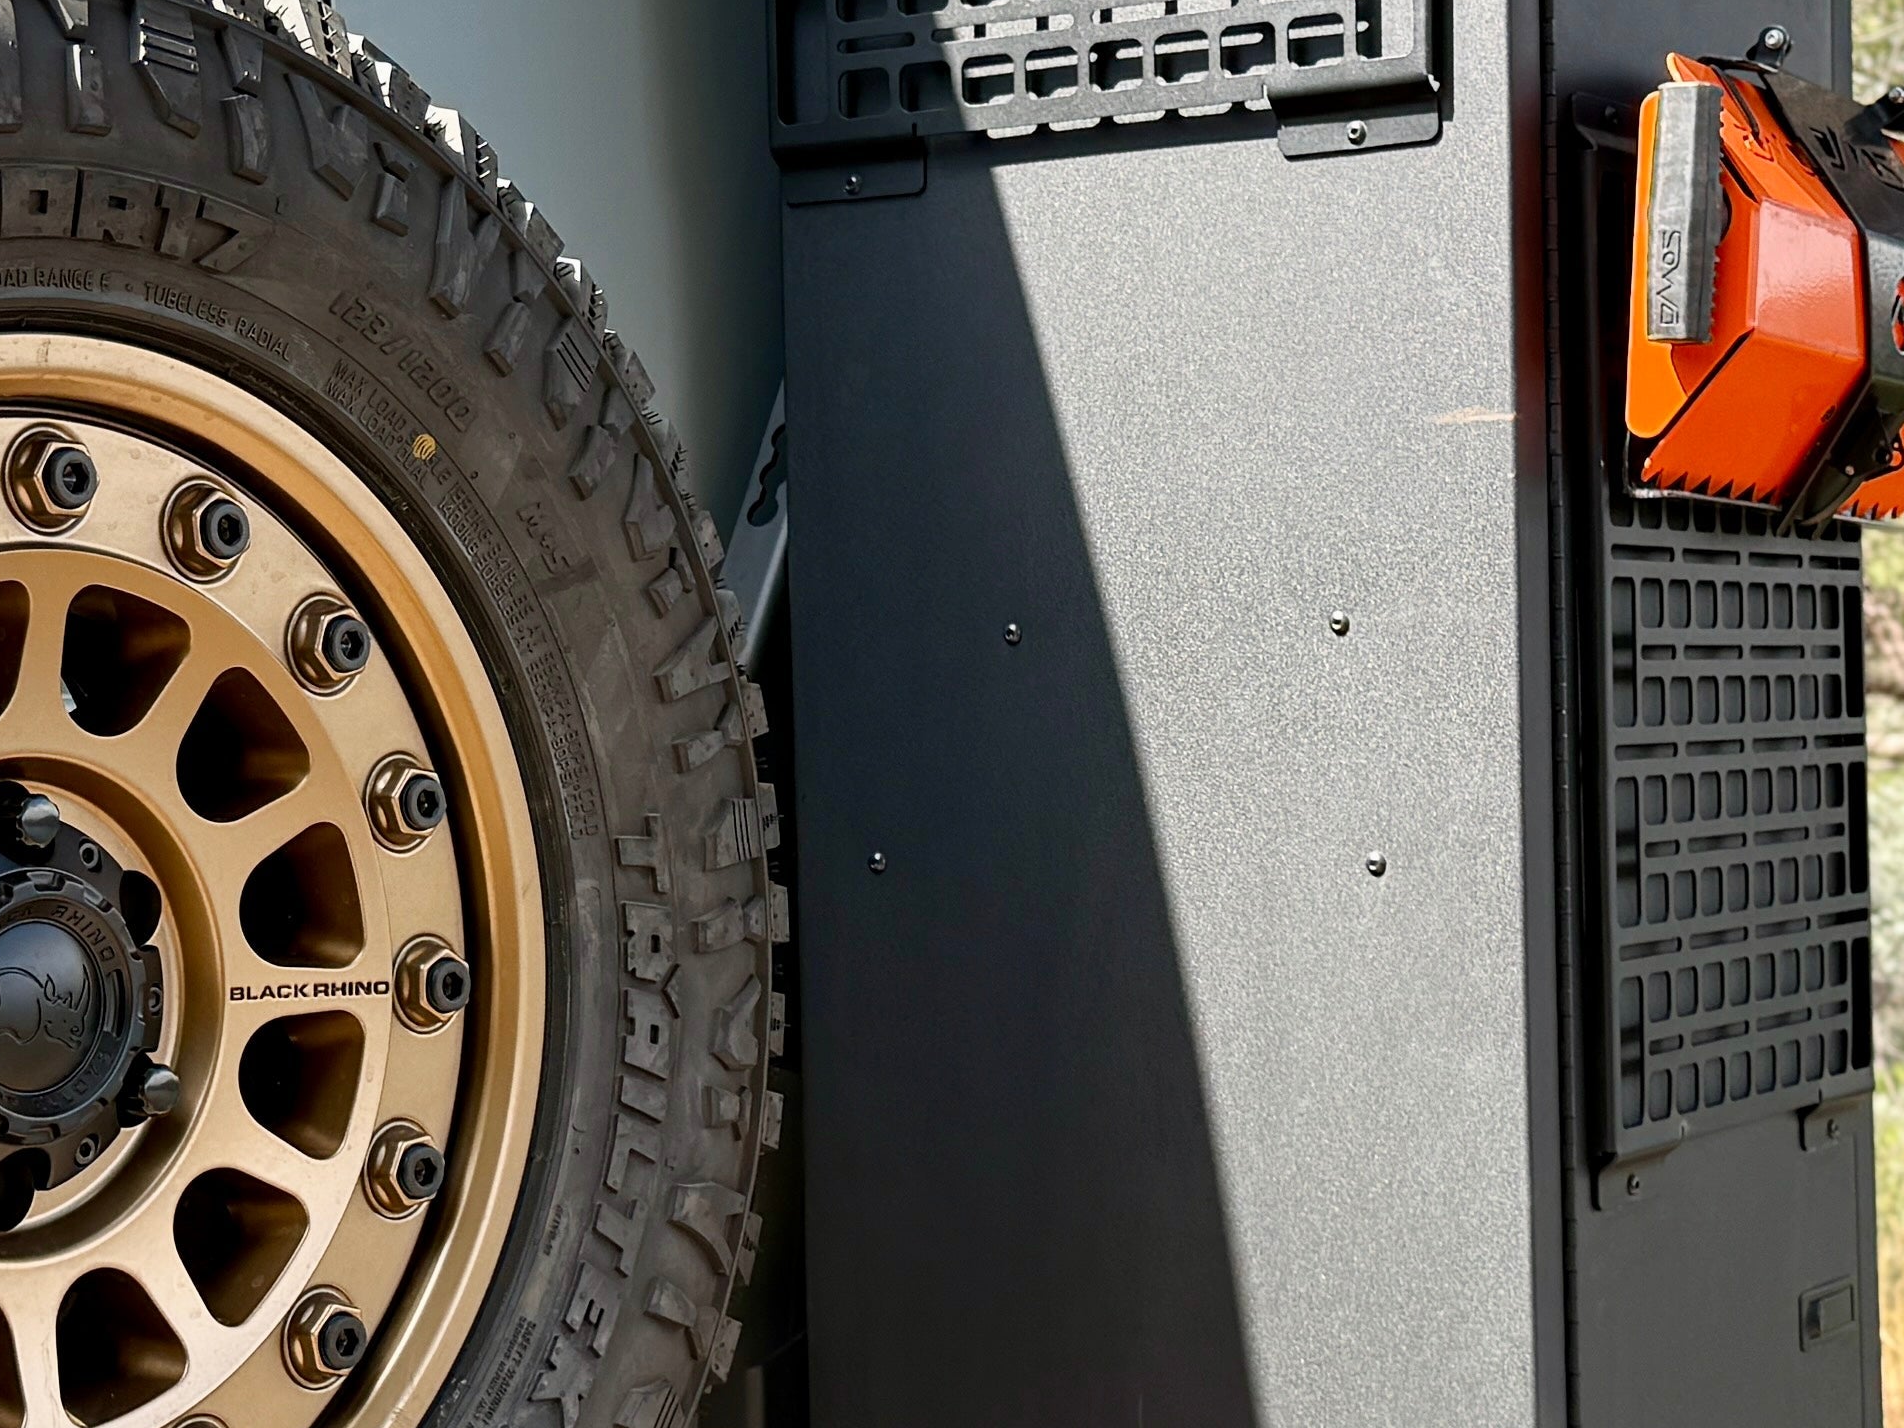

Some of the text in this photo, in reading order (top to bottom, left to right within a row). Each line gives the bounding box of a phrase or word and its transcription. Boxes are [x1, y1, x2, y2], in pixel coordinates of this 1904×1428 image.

[33, 268, 92, 292] RANGE
[235, 314, 294, 363] RADIAL
[325, 376, 358, 416] MAX
[358, 404, 398, 450] LOAD
[333, 358, 368, 396] MAX
[369, 386, 408, 434] LOAD
